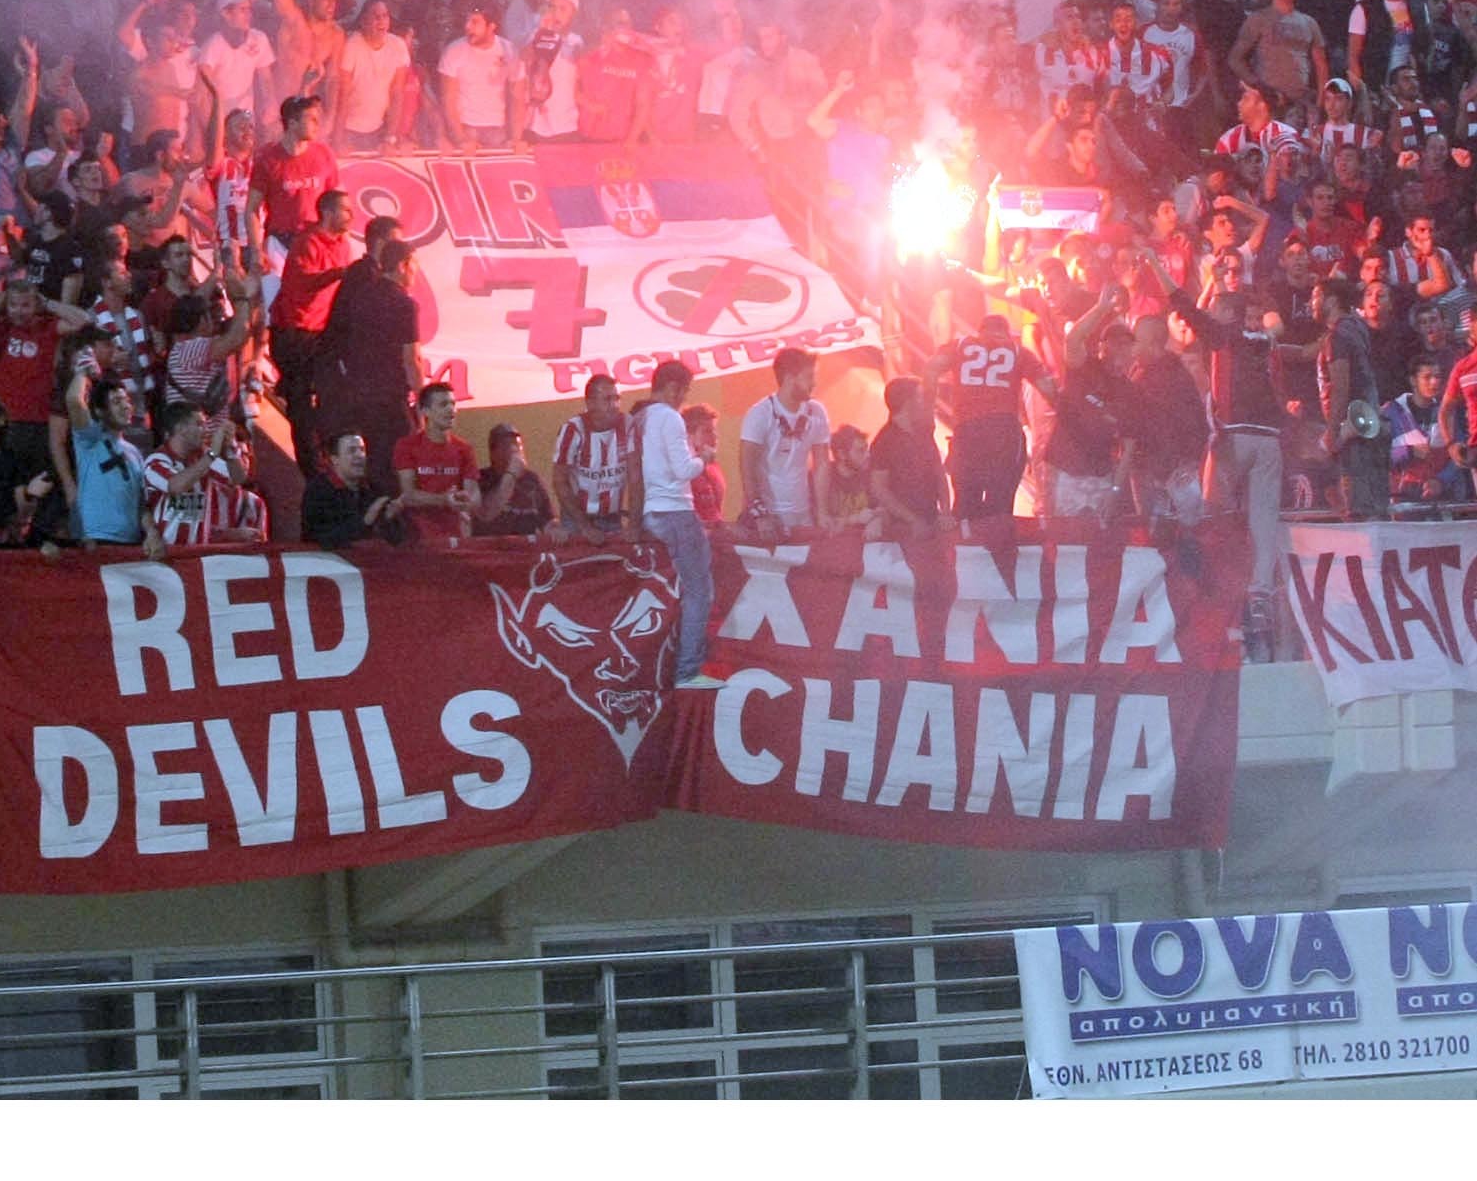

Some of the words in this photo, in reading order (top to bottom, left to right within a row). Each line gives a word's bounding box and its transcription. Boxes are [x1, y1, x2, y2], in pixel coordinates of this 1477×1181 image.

[960, 344, 1015, 387] 22
[100, 551, 369, 696] RED
[33, 689, 532, 859] DEVILS
[714, 668, 1177, 821] CHANIA
[1055, 910, 1355, 1003] NOVA
[1079, 994, 1346, 1036] απολυμαντική
[1237, 1048, 1263, 1071] 68
[1343, 1041, 1391, 1063] 2810
[1398, 1034, 1470, 1059] 321700
